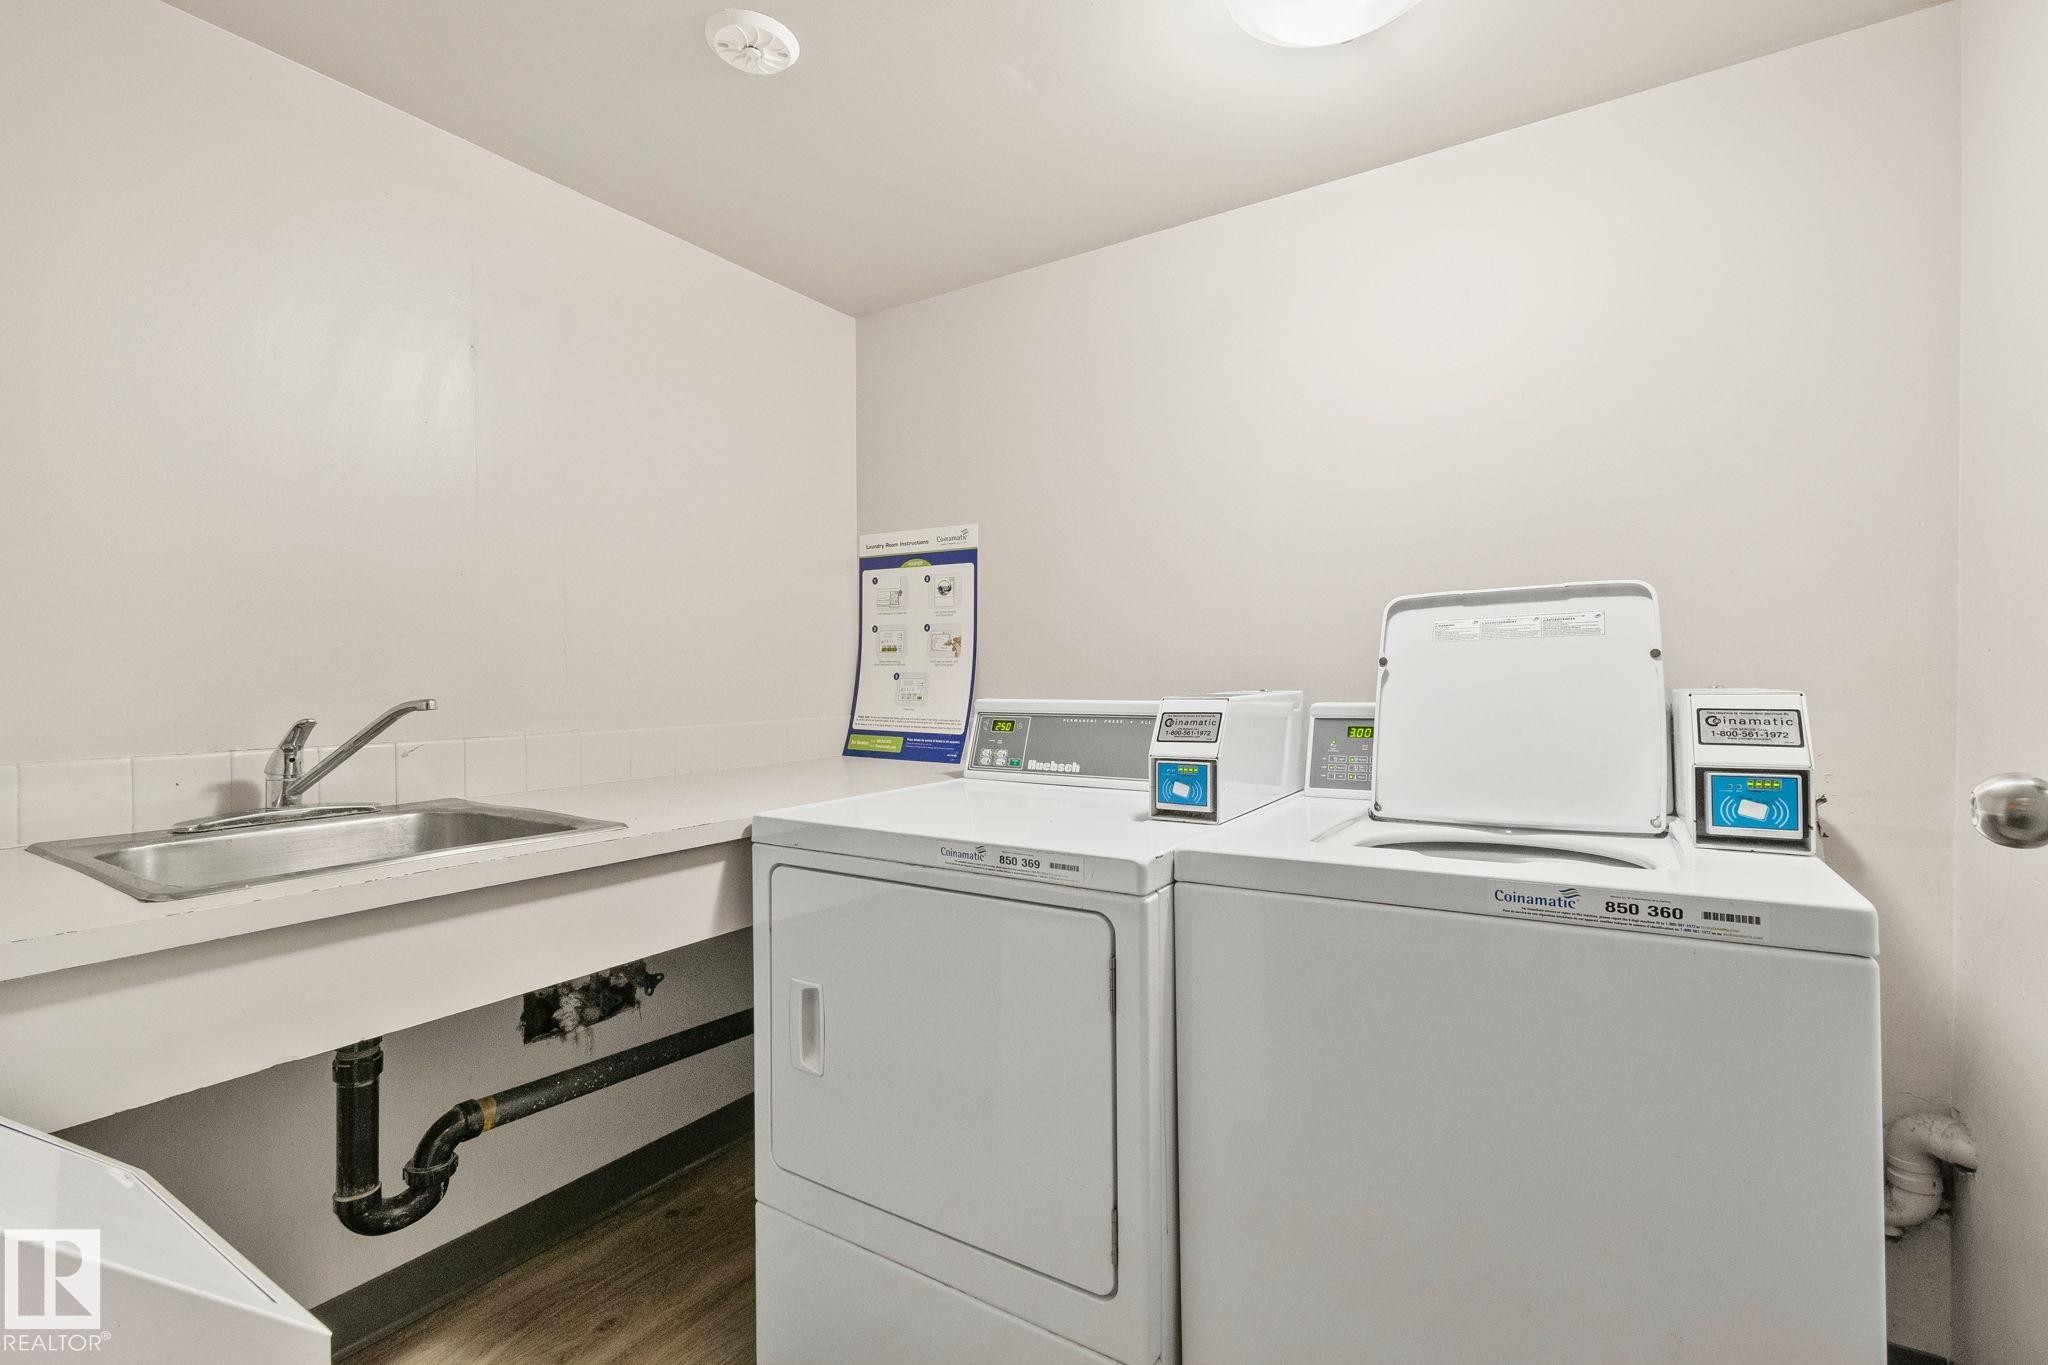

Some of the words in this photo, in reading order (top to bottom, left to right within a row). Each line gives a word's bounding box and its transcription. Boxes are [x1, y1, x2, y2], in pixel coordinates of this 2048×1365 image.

[866, 543, 884, 551] Laundry
[900, 539, 929, 547] Instructions
[1705, 715, 1794, 727] Coinamatic
[1711, 730, 1789, 739] 1-800-561-1972
[1027, 759, 1081, 773] Huebsch
[940, 846, 984, 862] Coinamatic
[999, 855, 1018, 866] 850
[1021, 858, 1041, 869] 369
[1494, 889, 1577, 910] Coinamatic
[1605, 901, 1640, 915] 850
[1647, 905, 1684, 920] 360
